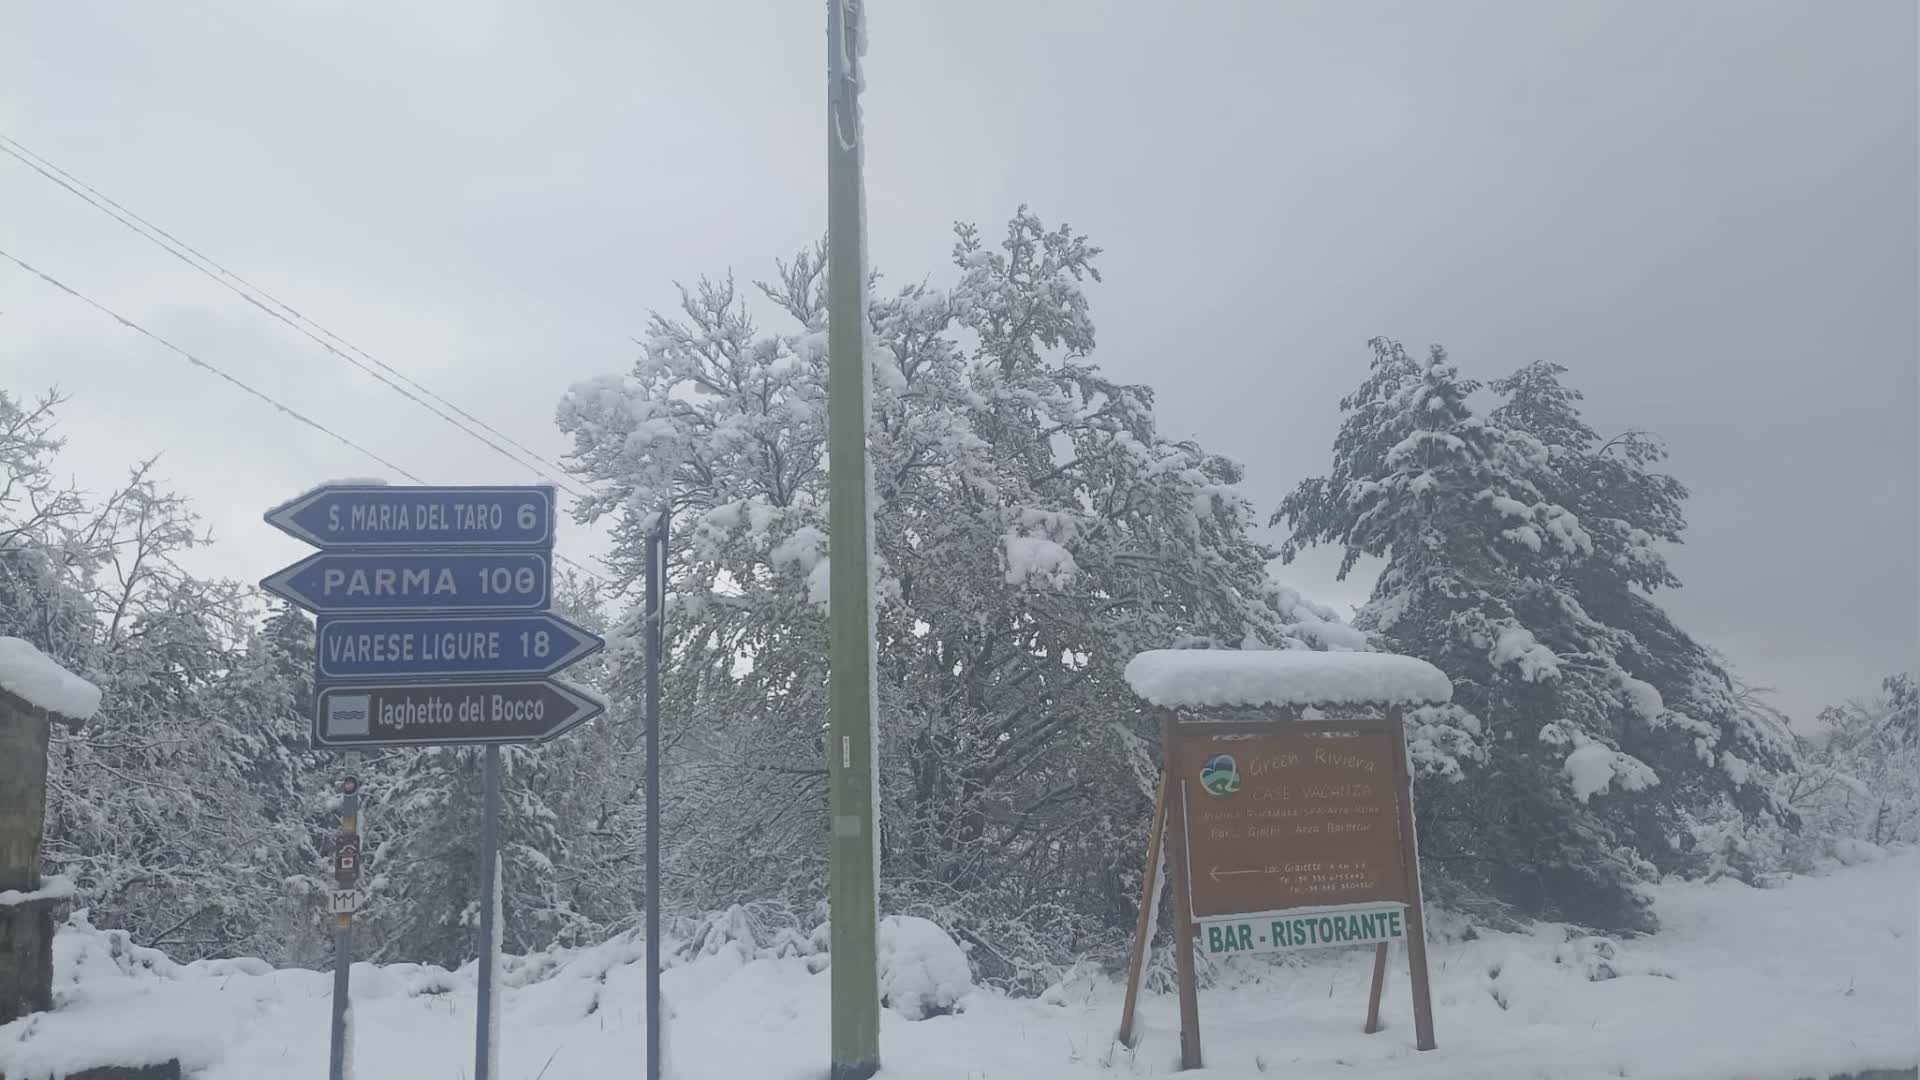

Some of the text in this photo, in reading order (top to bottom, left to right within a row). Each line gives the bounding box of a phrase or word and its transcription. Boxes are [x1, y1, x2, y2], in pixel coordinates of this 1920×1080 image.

[328, 503, 536, 531] S. MARIA DEL TARO 6
[323, 568, 535, 595] PARMA 100
[328, 631, 549, 662] VARESE LIGURE 18
[378, 695, 544, 729] laghetto del Bocco
[1249, 747, 1376, 776] Green Riviera
[1209, 925, 1254, 953] BAR
[1271, 912, 1402, 948] RISTORANTE
